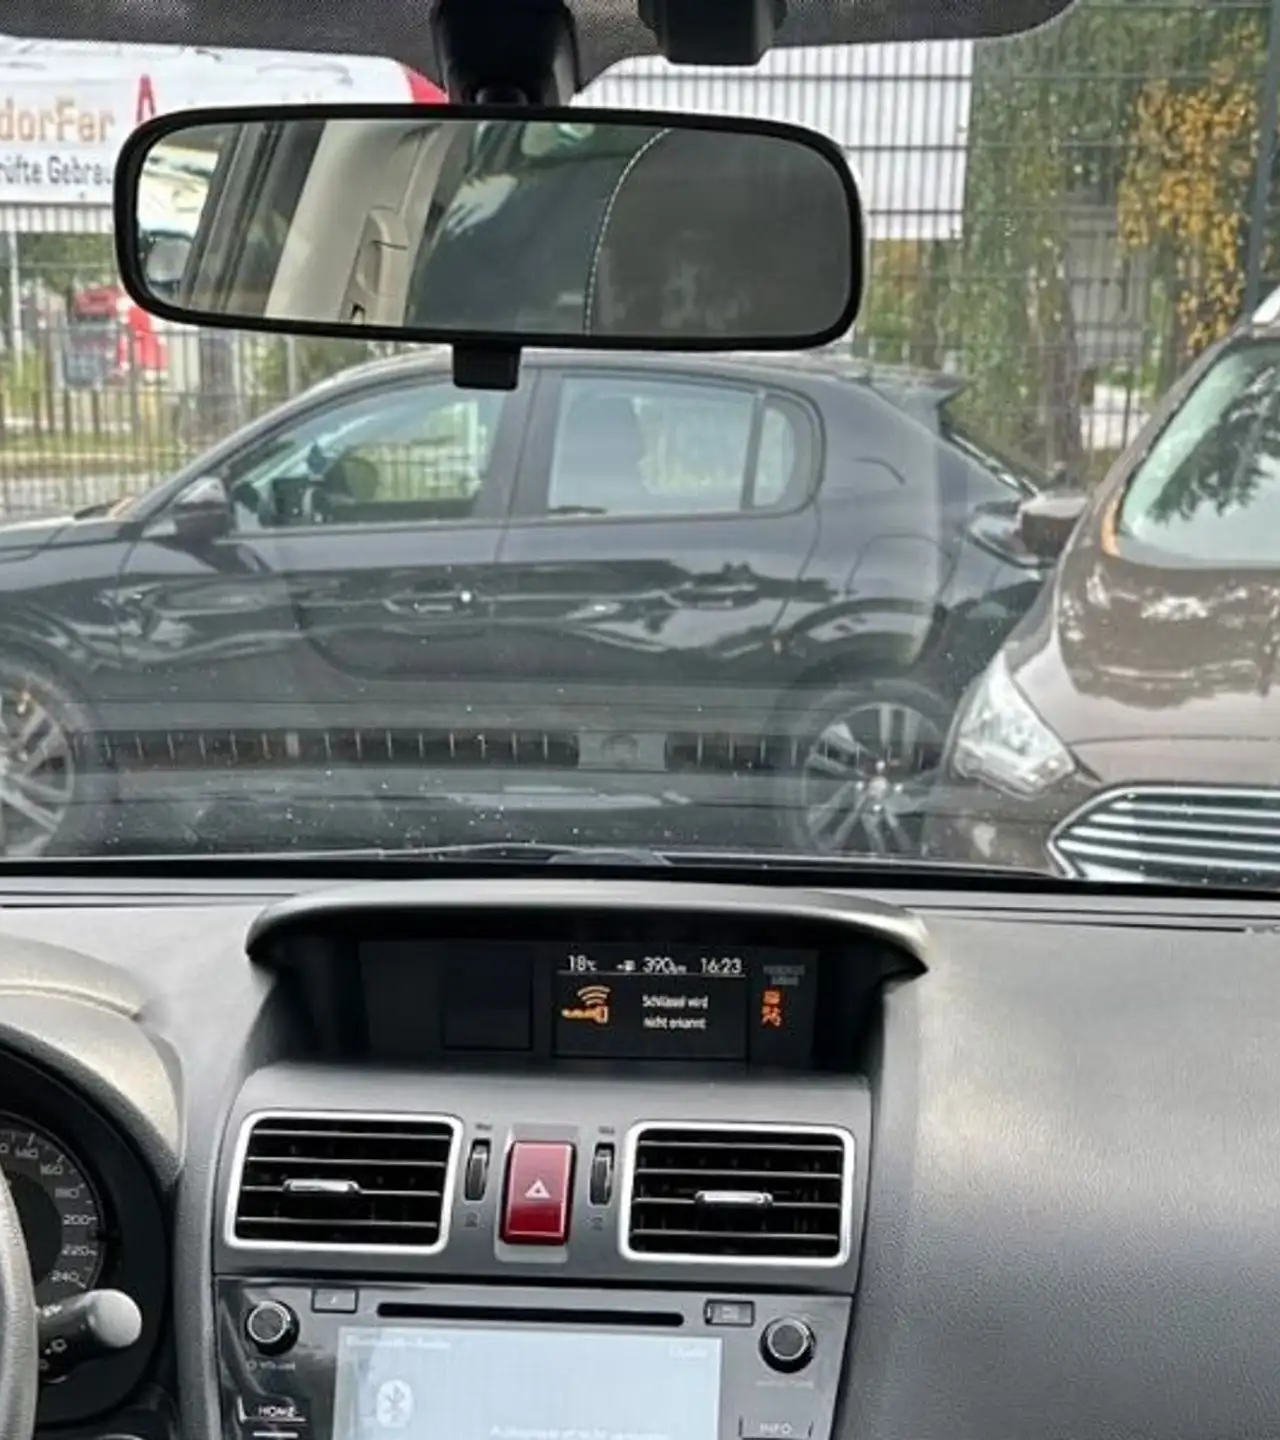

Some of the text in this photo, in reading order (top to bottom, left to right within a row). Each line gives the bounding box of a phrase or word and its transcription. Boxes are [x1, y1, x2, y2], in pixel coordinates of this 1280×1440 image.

[699, 957, 742, 975] 16:23
[63, 1214, 89, 1226] 200
[51, 1270, 78, 1282] 240
[258, 1406, 296, 1418] HOME
